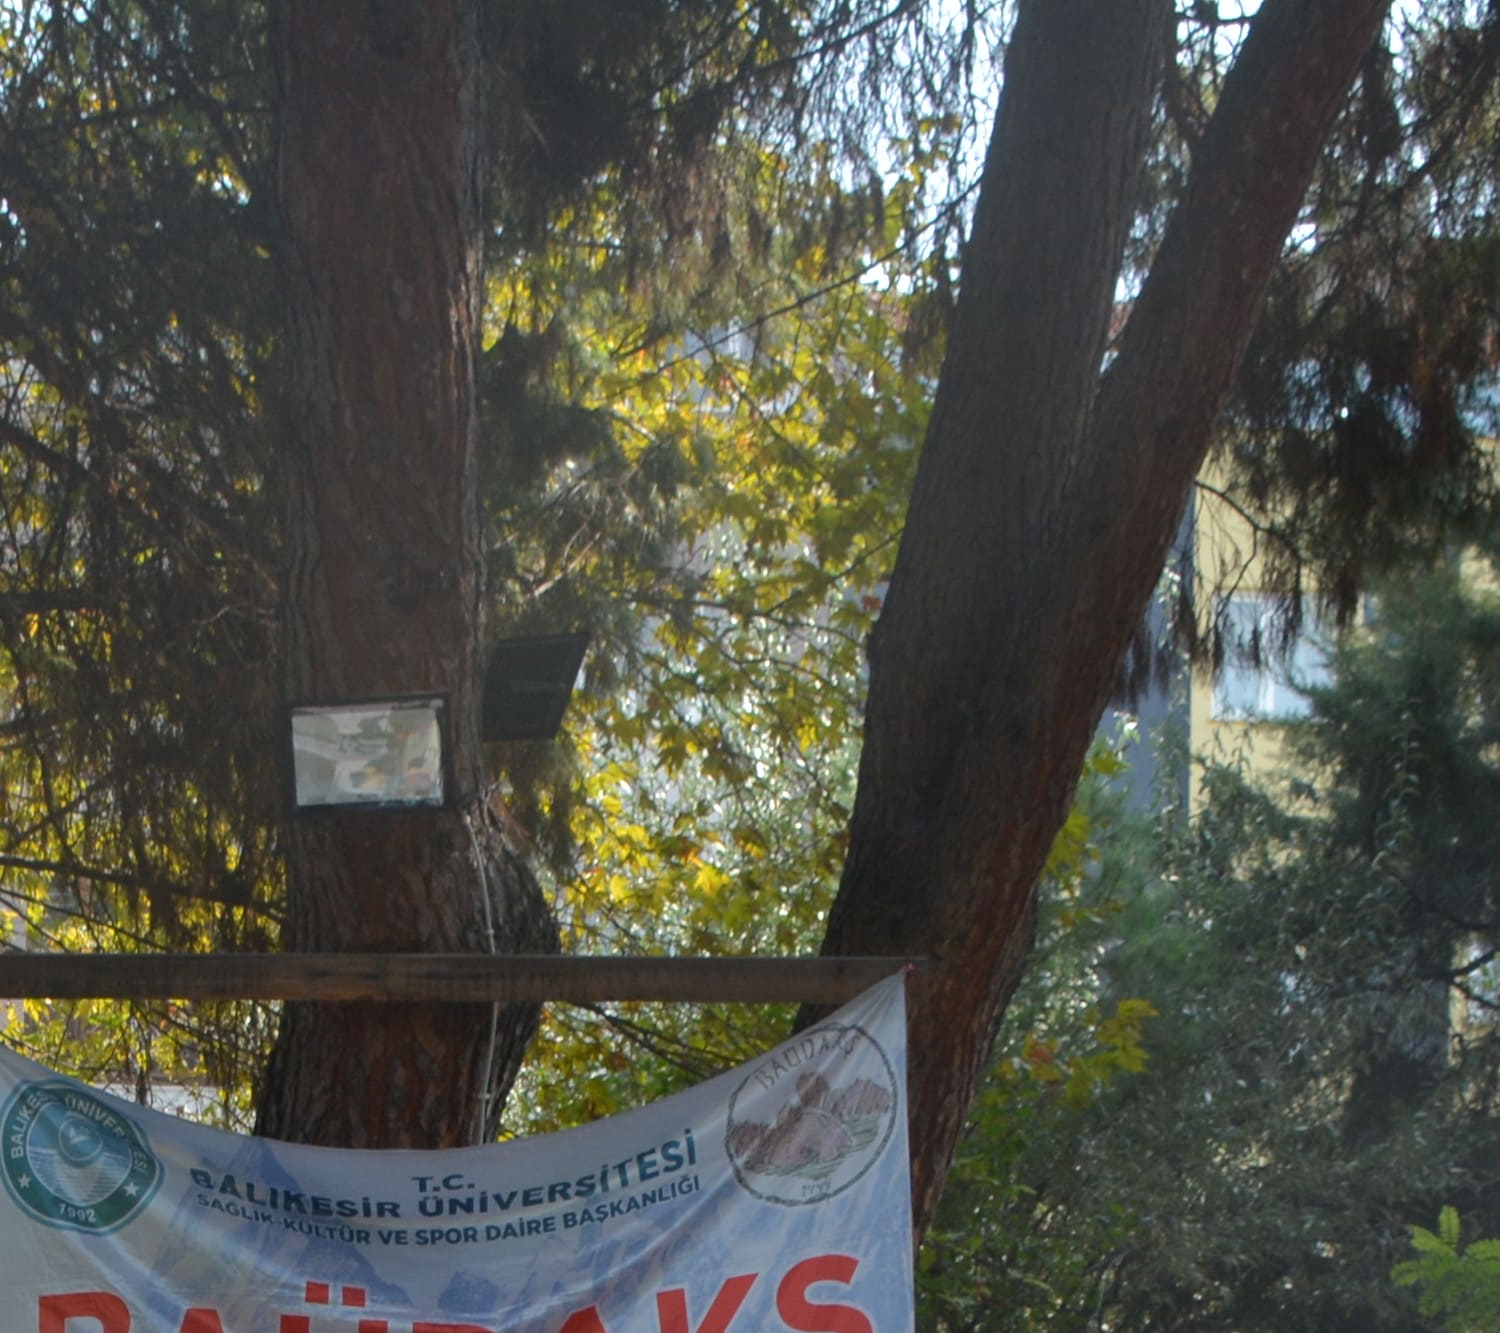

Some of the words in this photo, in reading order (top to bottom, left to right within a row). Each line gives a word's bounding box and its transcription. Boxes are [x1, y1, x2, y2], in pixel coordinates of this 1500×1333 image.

[190, 1167, 401, 1219] BALIKESİR
[418, 1127, 698, 1218] ÜNİVERSİTESİ
[379, 1228, 409, 1246] VE
[415, 1226, 478, 1246] SPOR
[485, 1215, 557, 1243] DAİRE
[563, 1172, 700, 1231] BAŞKANLIĞI
[411, 1173, 476, 1194] T.C.
